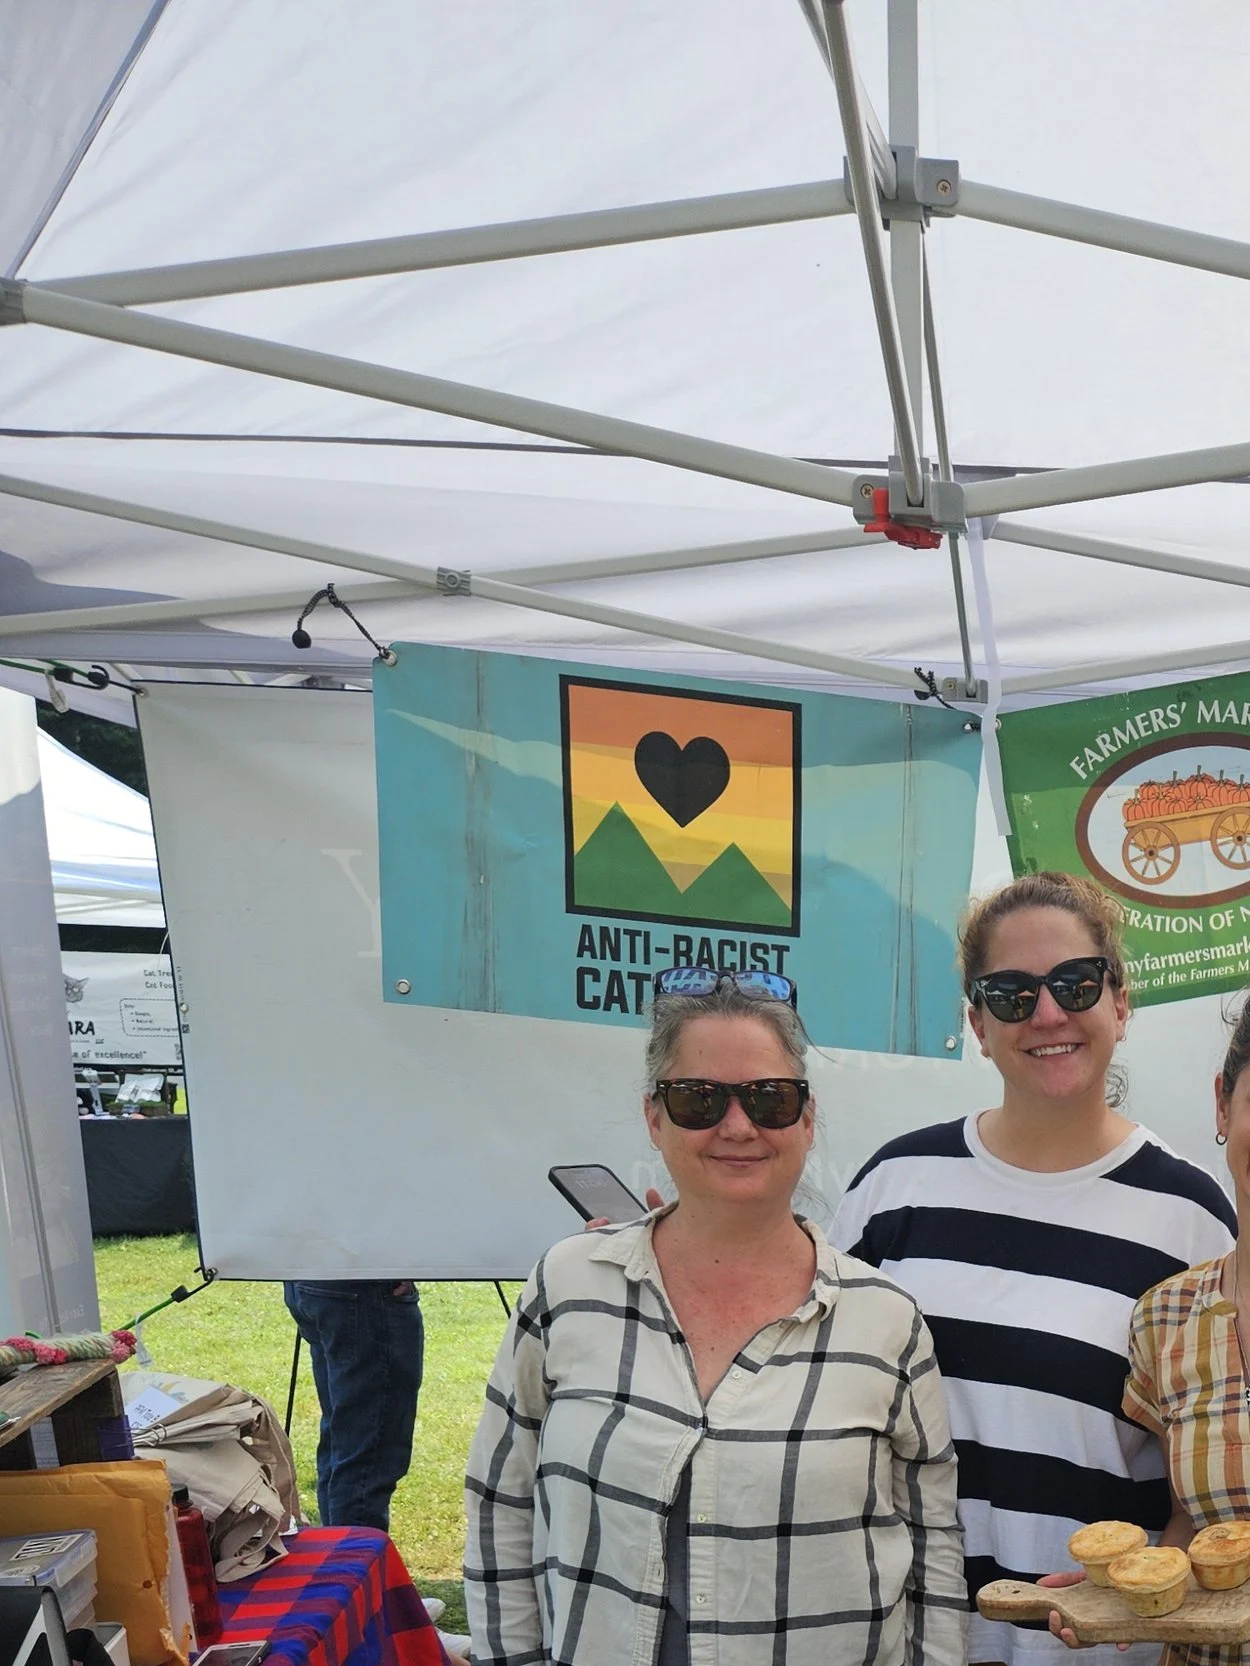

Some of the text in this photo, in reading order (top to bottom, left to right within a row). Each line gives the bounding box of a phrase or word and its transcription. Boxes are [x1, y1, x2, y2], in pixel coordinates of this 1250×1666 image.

[1070, 702, 1186, 779] FARMERS'
[1209, 910, 1235, 930] OF
[576, 924, 790, 974] ANTI-RACIST
[1152, 973, 1166, 986] of
[1168, 969, 1186, 983] the
[1190, 964, 1235, 980] Farmers
[82, 1050, 90, 1058] of
